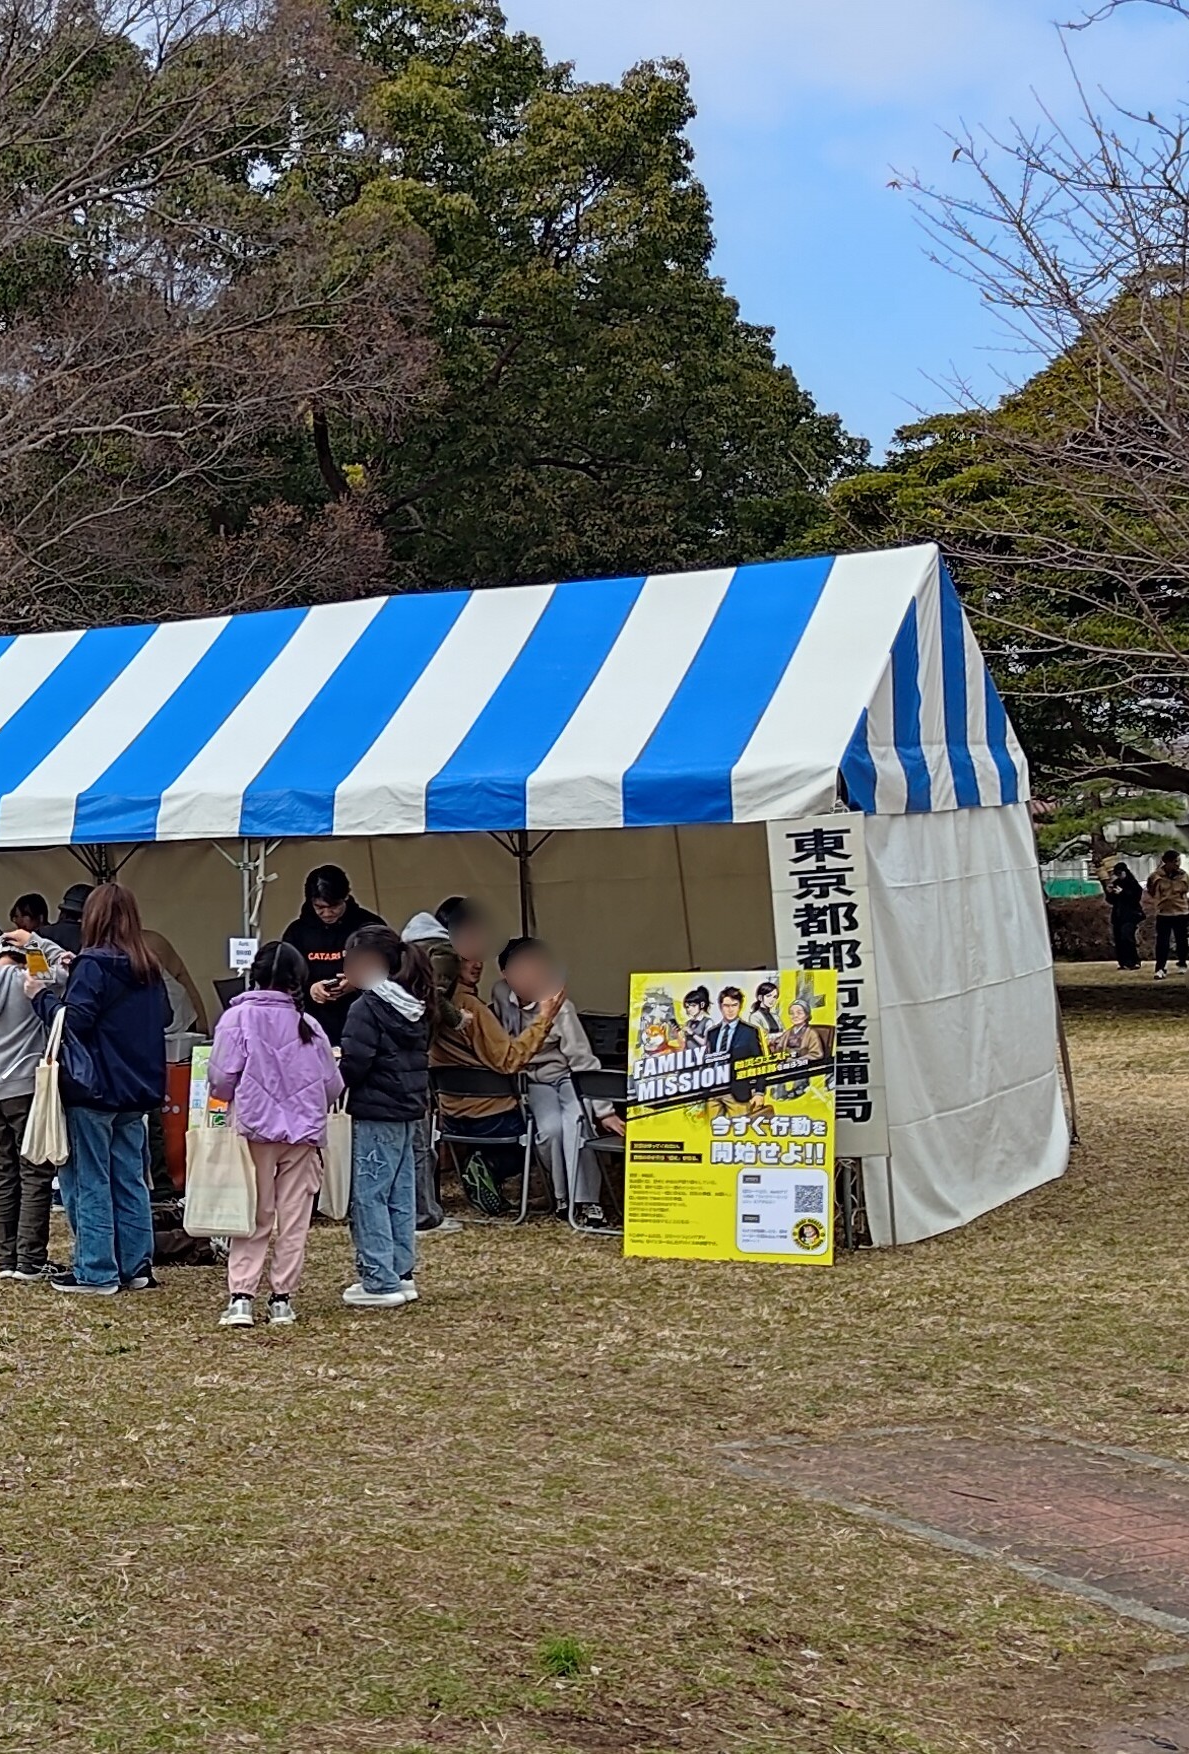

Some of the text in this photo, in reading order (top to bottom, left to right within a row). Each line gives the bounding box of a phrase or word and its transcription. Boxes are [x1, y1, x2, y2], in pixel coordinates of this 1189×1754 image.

[633, 1046, 707, 1080] FAMILY
[638, 1064, 730, 1102] MISSION
[711, 1116, 827, 1137] 今すぐ行動を
[710, 1141, 826, 1165] 開始せよ!!
